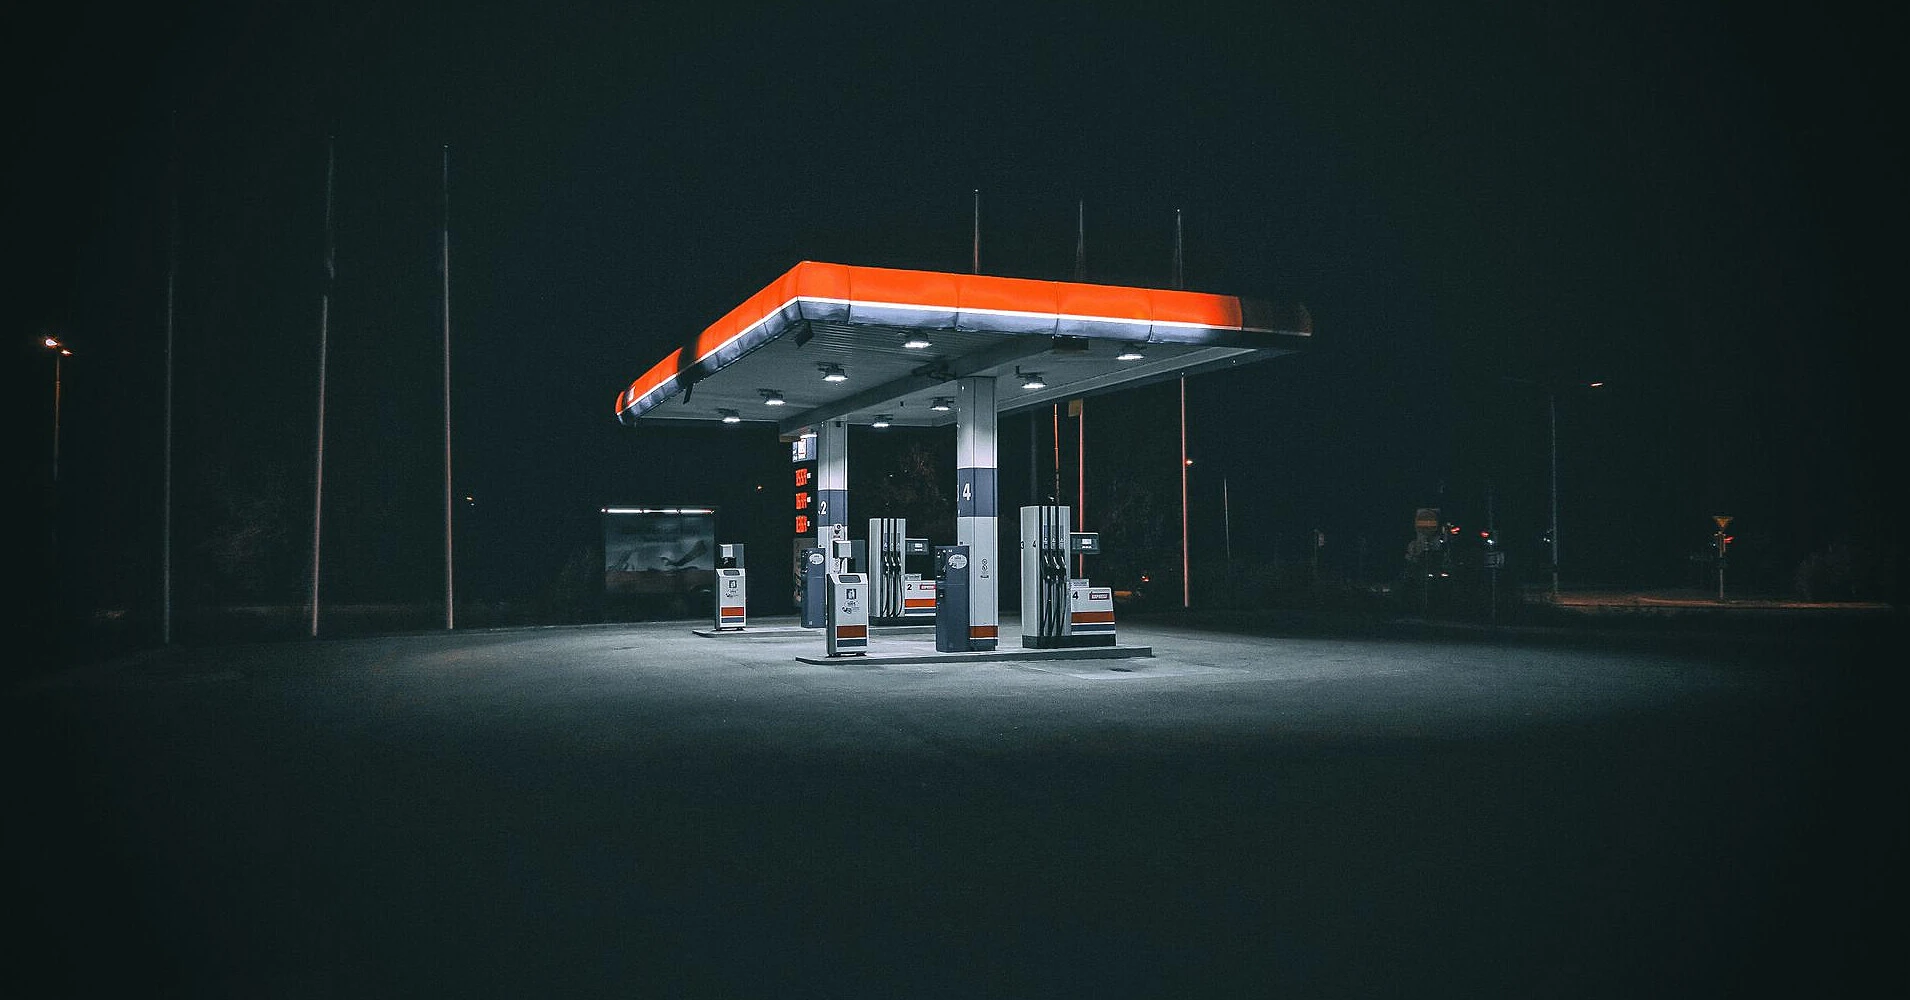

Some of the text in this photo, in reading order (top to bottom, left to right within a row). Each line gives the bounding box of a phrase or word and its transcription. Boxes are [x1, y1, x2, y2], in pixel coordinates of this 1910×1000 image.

[963, 483, 971, 501] 4
[820, 501, 827, 515] 2
[1072, 591, 1079, 600] 4
